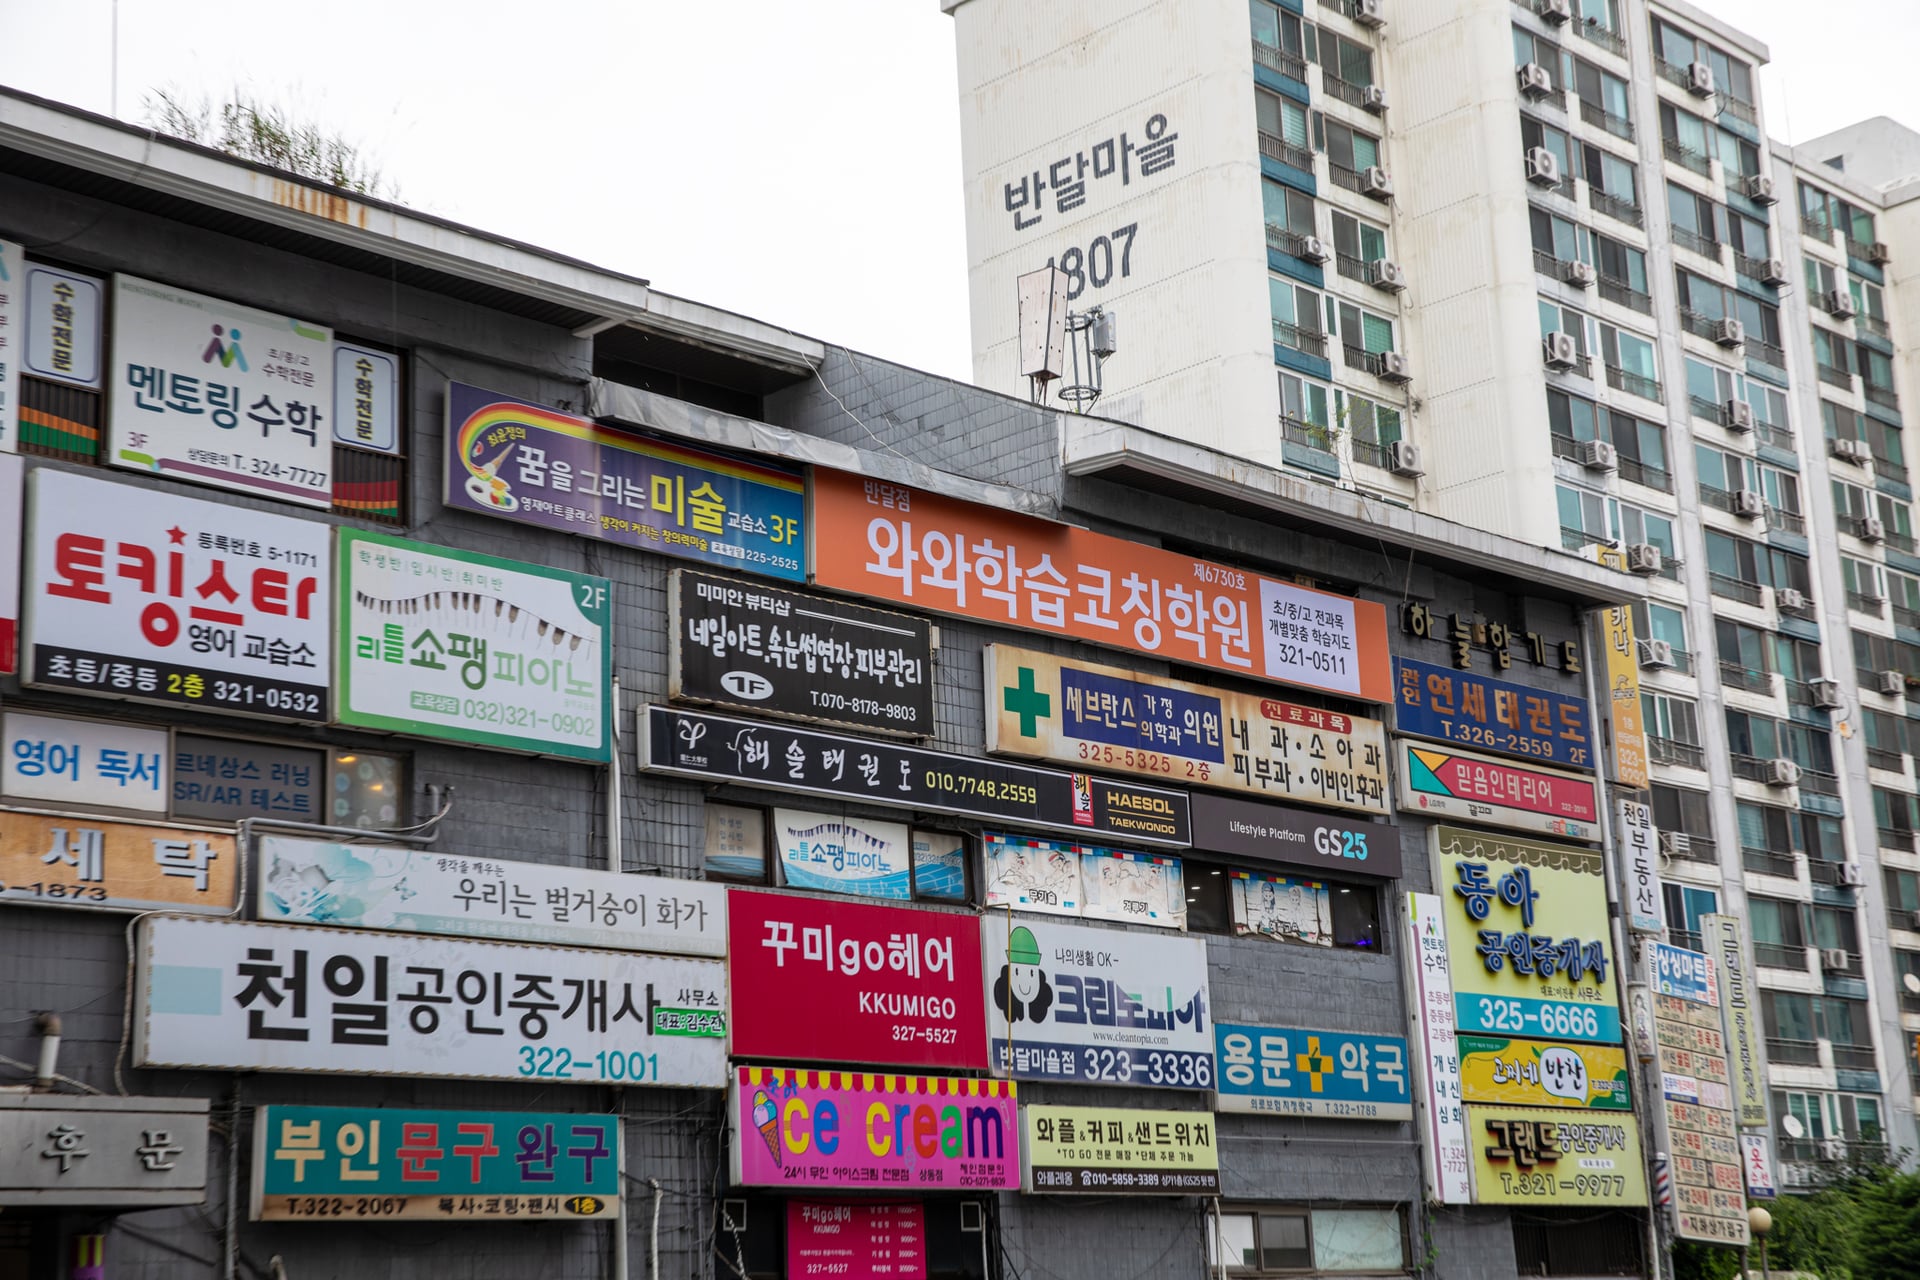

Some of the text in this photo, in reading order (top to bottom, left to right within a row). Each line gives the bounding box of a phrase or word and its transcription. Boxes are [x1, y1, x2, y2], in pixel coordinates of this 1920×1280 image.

[1004, 113, 1178, 231] 반달마을
[1047, 222, 1138, 301] 807
[51, 281, 75, 373] 수학전문
[261, 363, 315, 388] 수학전문
[126, 363, 323, 448] 멘토링 수학
[355, 357, 374, 441] 수학전문
[127, 431, 149, 448] 3F
[251, 458, 328, 488] 324-7727
[516, 445, 798, 545] 꿈을 그리는 미술 교습소 3F
[864, 479, 911, 513] 반달점
[197, 532, 318, 567] 등록번호 5-1171
[520, 496, 597, 525] 영재아트클래스
[600, 515, 629, 533] 생각이
[631, 521, 659, 542] 커지는
[745, 549, 799, 571] 225-2525
[46, 526, 317, 648] 토킹스타
[1193, 562, 1248, 592] 제6730호
[581, 585, 606, 609] 2F
[696, 582, 791, 617] 미미안 뷰티샵
[1273, 599, 1345, 631] 초/중/고 전과목
[188, 625, 317, 668] 영어 교습소
[1269, 617, 1352, 651] 개별맞춤 학습지도
[1404, 602, 1582, 674] 하늘합기도
[1279, 643, 1346, 676] 321-0511
[48, 655, 319, 713] 초등/중등 2층 321-0532
[464, 699, 596, 737] 032)321-0902
[810, 690, 917, 721] T.070-8178-9803
[1066, 686, 1220, 748] 세브란스 가정 의원
[1266, 702, 1345, 732] 진료과목
[1401, 667, 1586, 743] 관인 연세태권도
[1141, 720, 1182, 747] 의학과
[1441, 720, 1587, 764] T.326-2559 2F
[12, 738, 161, 791] 영어 독서
[175, 753, 311, 788] 르네상스 러닝
[1078, 742, 1212, 782] 325-5325 2층
[174, 781, 311, 815] SR/AR 테스트
[925, 771, 1037, 805] 010.7748.2559
[1456, 764, 1553, 807] 믿음인테리어
[1107, 791, 1174, 815] HAESOL
[1624, 803, 1650, 830] 천일
[1109, 816, 1175, 835] TAEKWONDO
[1230, 820, 1368, 861] Lifestyle Platform GS25
[1631, 830, 1653, 915] 부동산
[453, 878, 709, 932] 우리는 벌거숭이 화가
[1453, 861, 1540, 928] 동아
[762, 920, 955, 982] 꾸미go헤어
[1422, 937, 1446, 953] 멘토링
[1476, 929, 1609, 984] 공인중개사
[1424, 955, 1447, 974] 수학
[676, 988, 719, 1006] 사무소
[859, 991, 956, 1019] KKUMIGO
[1428, 991, 1451, 1004] 초등부
[892, 1025, 957, 1044] 327-5527
[1479, 998, 1599, 1037] 325-6666
[1092, 1031, 1170, 1046] www.cleantopia.com
[518, 1046, 659, 1082] 322-1001
[1000, 1046, 1211, 1087] 반달마을점 323-3336
[1224, 1034, 1405, 1095] 용문 약국
[1434, 1055, 1457, 1075] 개념
[1545, 1057, 1582, 1090] 반찬
[1436, 1081, 1460, 1100] 내신
[1325, 1103, 1377, 1116] T.322-1788
[1439, 1106, 1462, 1125] 심화
[866, 1101, 1004, 1159] cream
[1486, 1120, 1562, 1166] 그랜드
[1557, 1122, 1625, 1155] 공인중개사
[274, 1119, 610, 1184] 부인 문구 완구
[1079, 1149, 1092, 1160] GO
[784, 1166, 944, 1182] 24시 무인 아이스크림 전문점 상동점
[1092, 1172, 1159, 1186] 010-5858-3389
[1501, 1173, 1625, 1197] T.321-9977
[286, 1197, 408, 1217] T.322-2067
